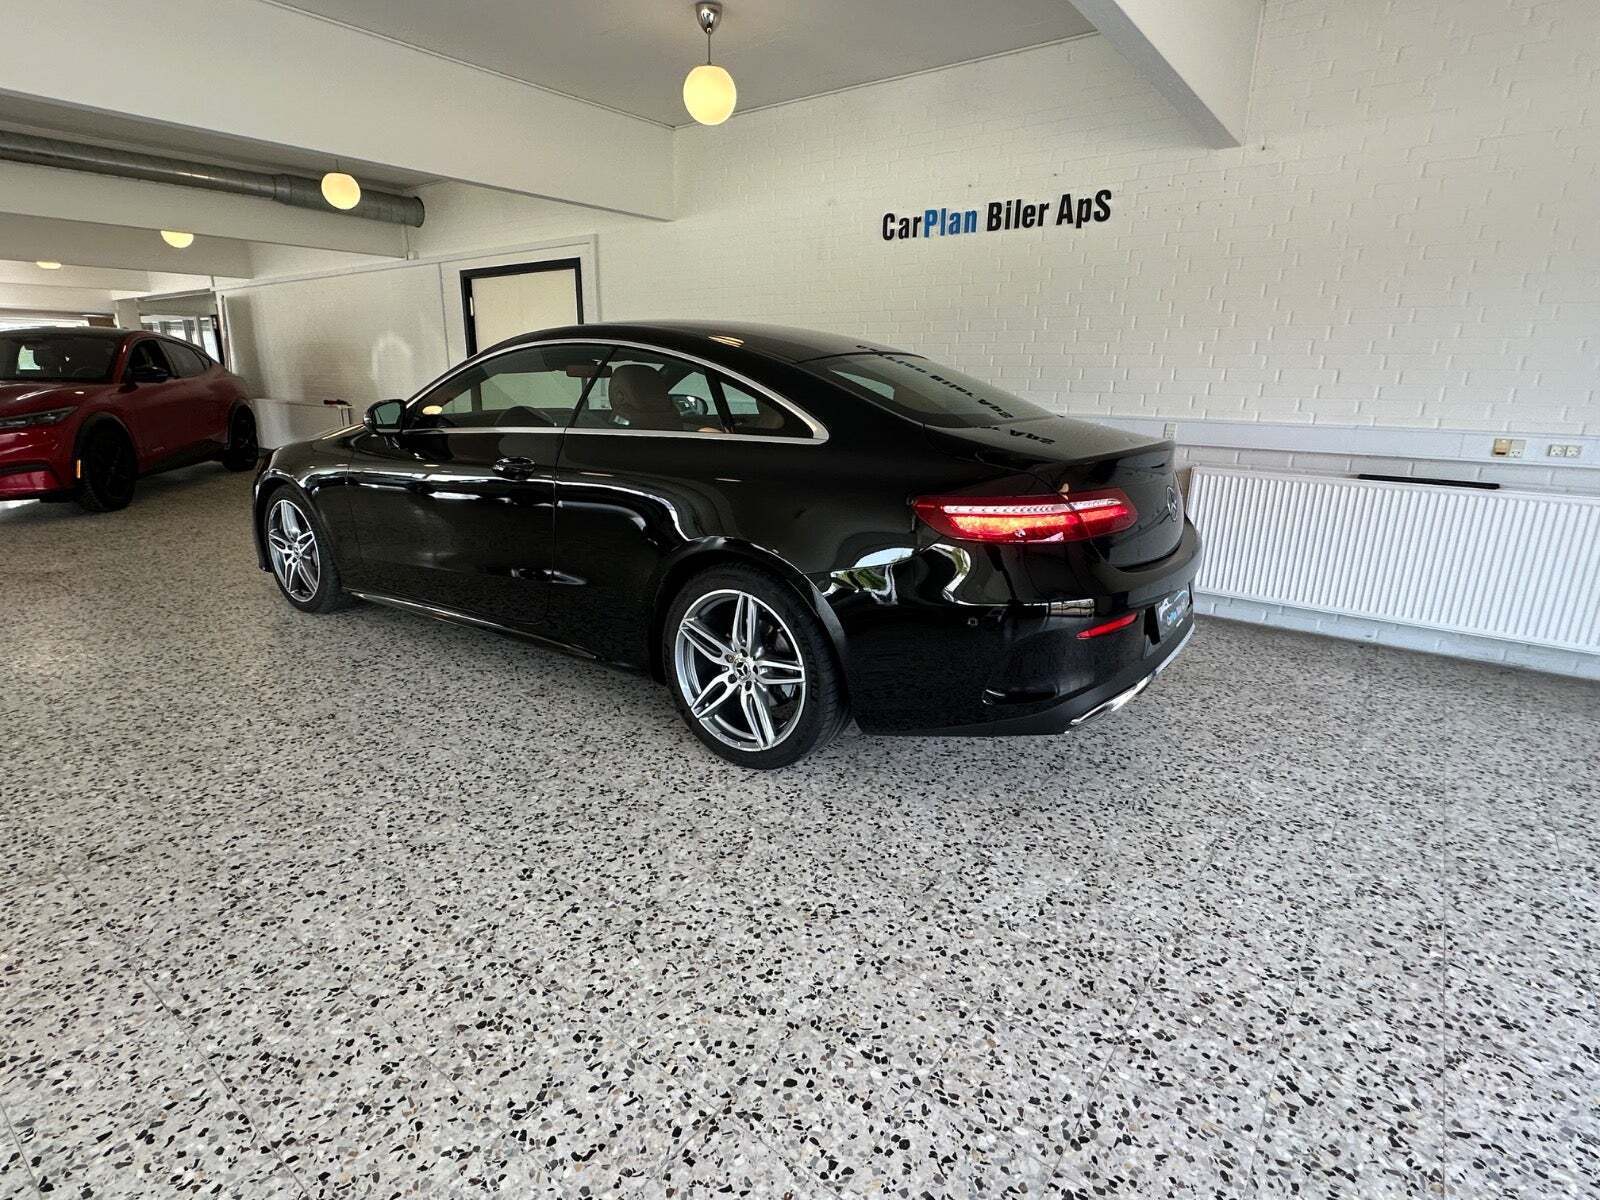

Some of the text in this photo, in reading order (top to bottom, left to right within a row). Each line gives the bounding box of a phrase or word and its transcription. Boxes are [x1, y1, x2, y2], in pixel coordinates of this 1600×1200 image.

[882, 189, 1112, 241] CarPlan Biler ApS
